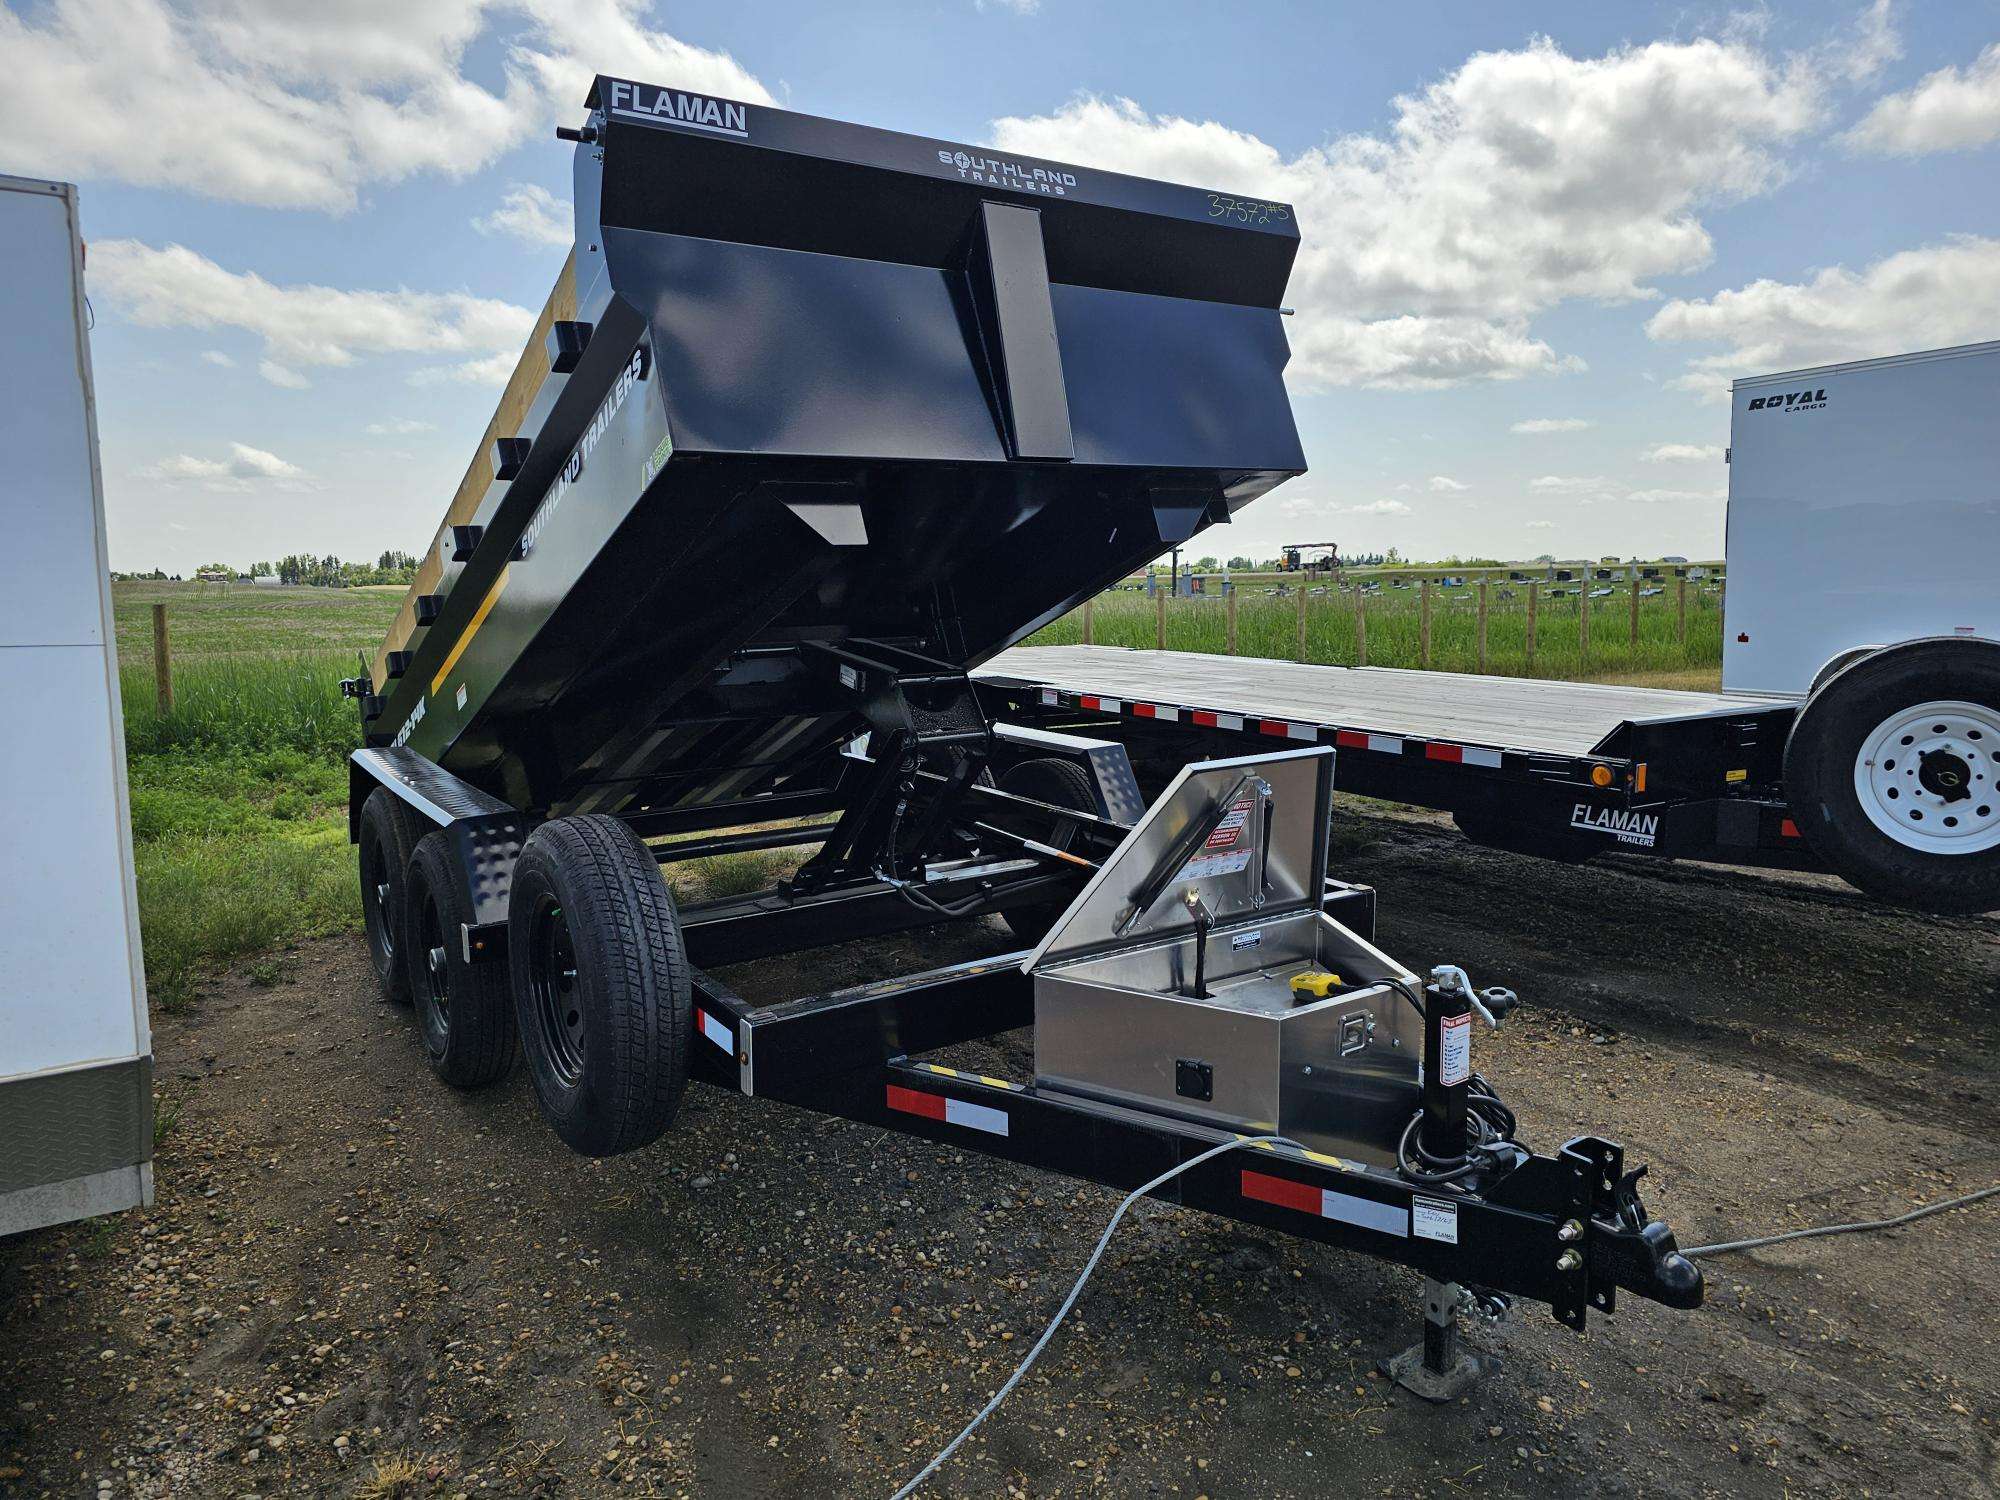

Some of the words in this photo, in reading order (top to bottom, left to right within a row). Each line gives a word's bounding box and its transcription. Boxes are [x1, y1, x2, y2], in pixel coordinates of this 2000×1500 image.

[611, 81, 746, 131] FLAMAN
[938, 150, 1077, 187] SOUTHLAND
[958, 168, 1065, 195] TRAILERS
[1748, 388, 1828, 411] ROYAL
[1784, 403, 1826, 413] CARGO
[521, 451, 580, 557] SOUTHLAND
[581, 349, 642, 461] TRAILERS
[1571, 803, 1659, 835] FLAMAN
[1616, 834, 1655, 847] TRAILERS
